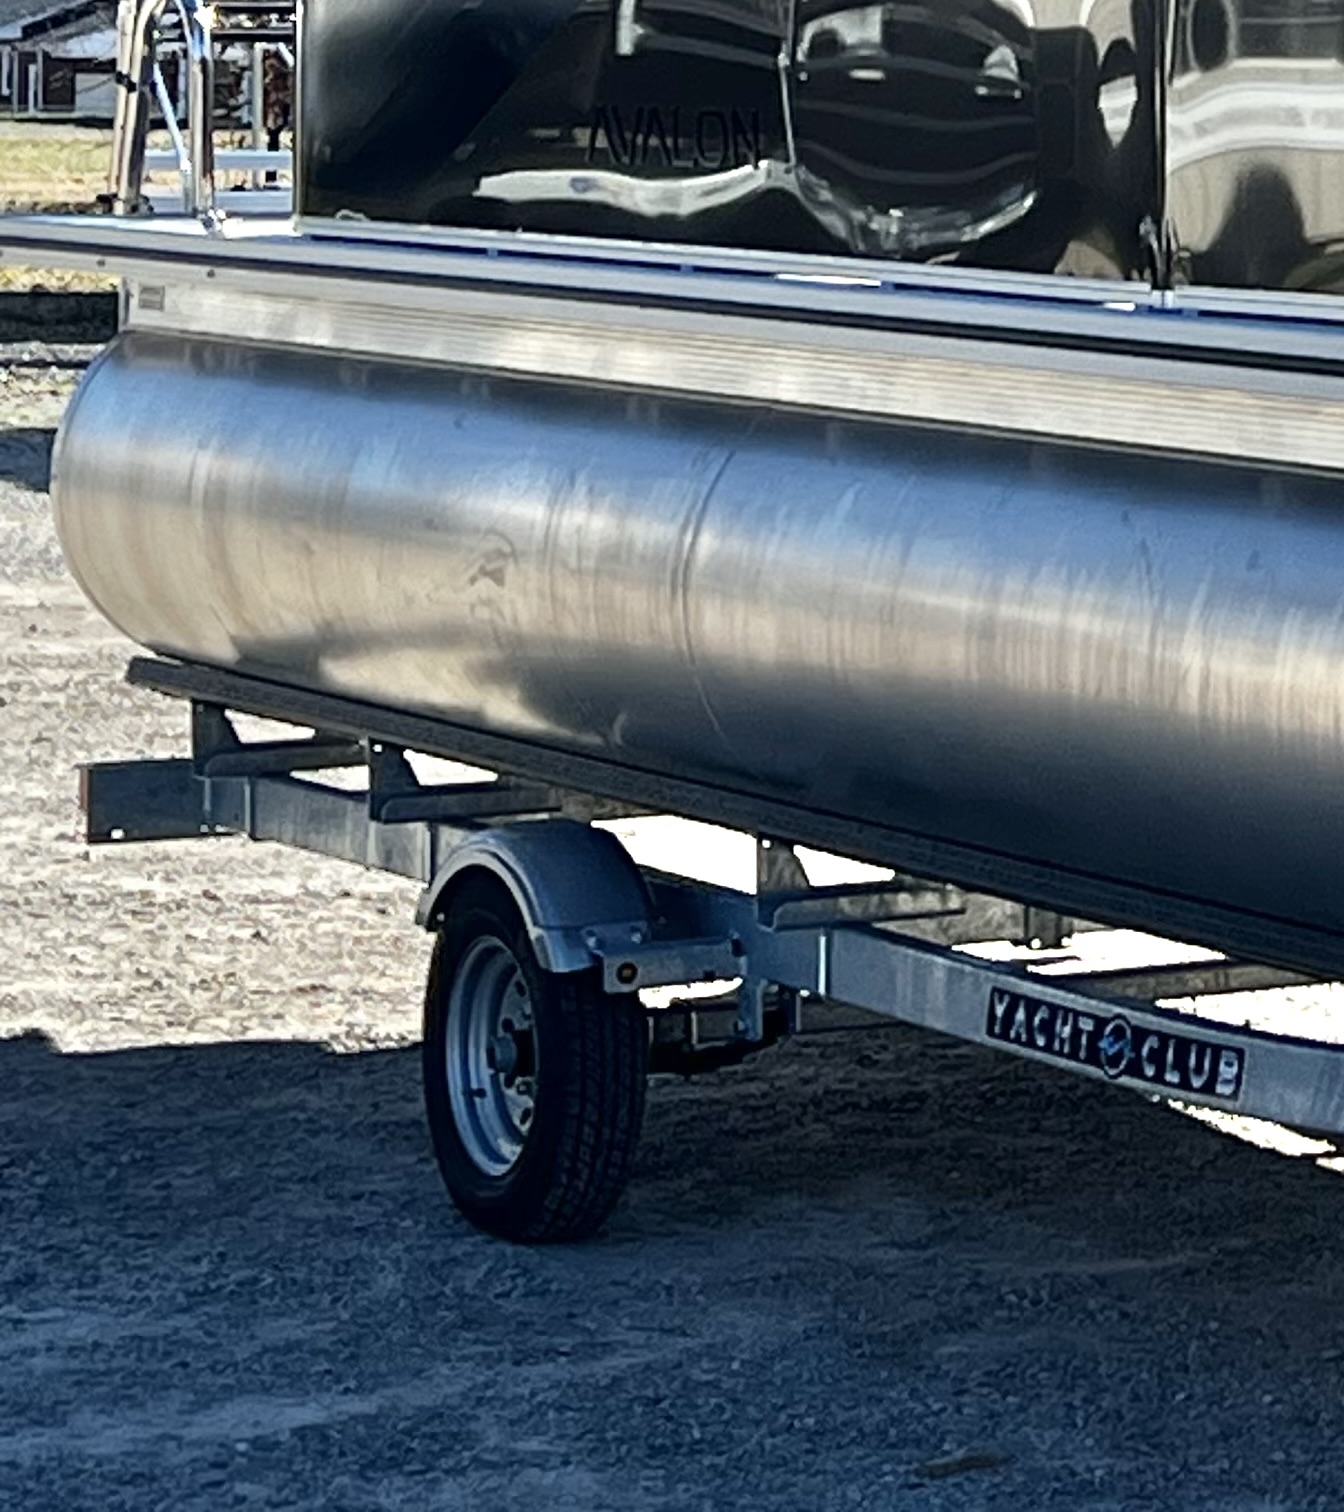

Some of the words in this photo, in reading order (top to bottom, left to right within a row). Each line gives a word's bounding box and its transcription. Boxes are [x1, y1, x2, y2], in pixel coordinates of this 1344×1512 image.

[584, 104, 761, 170] AVALON
[992, 989, 1096, 1061] YACHT
[1141, 1034, 1239, 1096] CLUB
